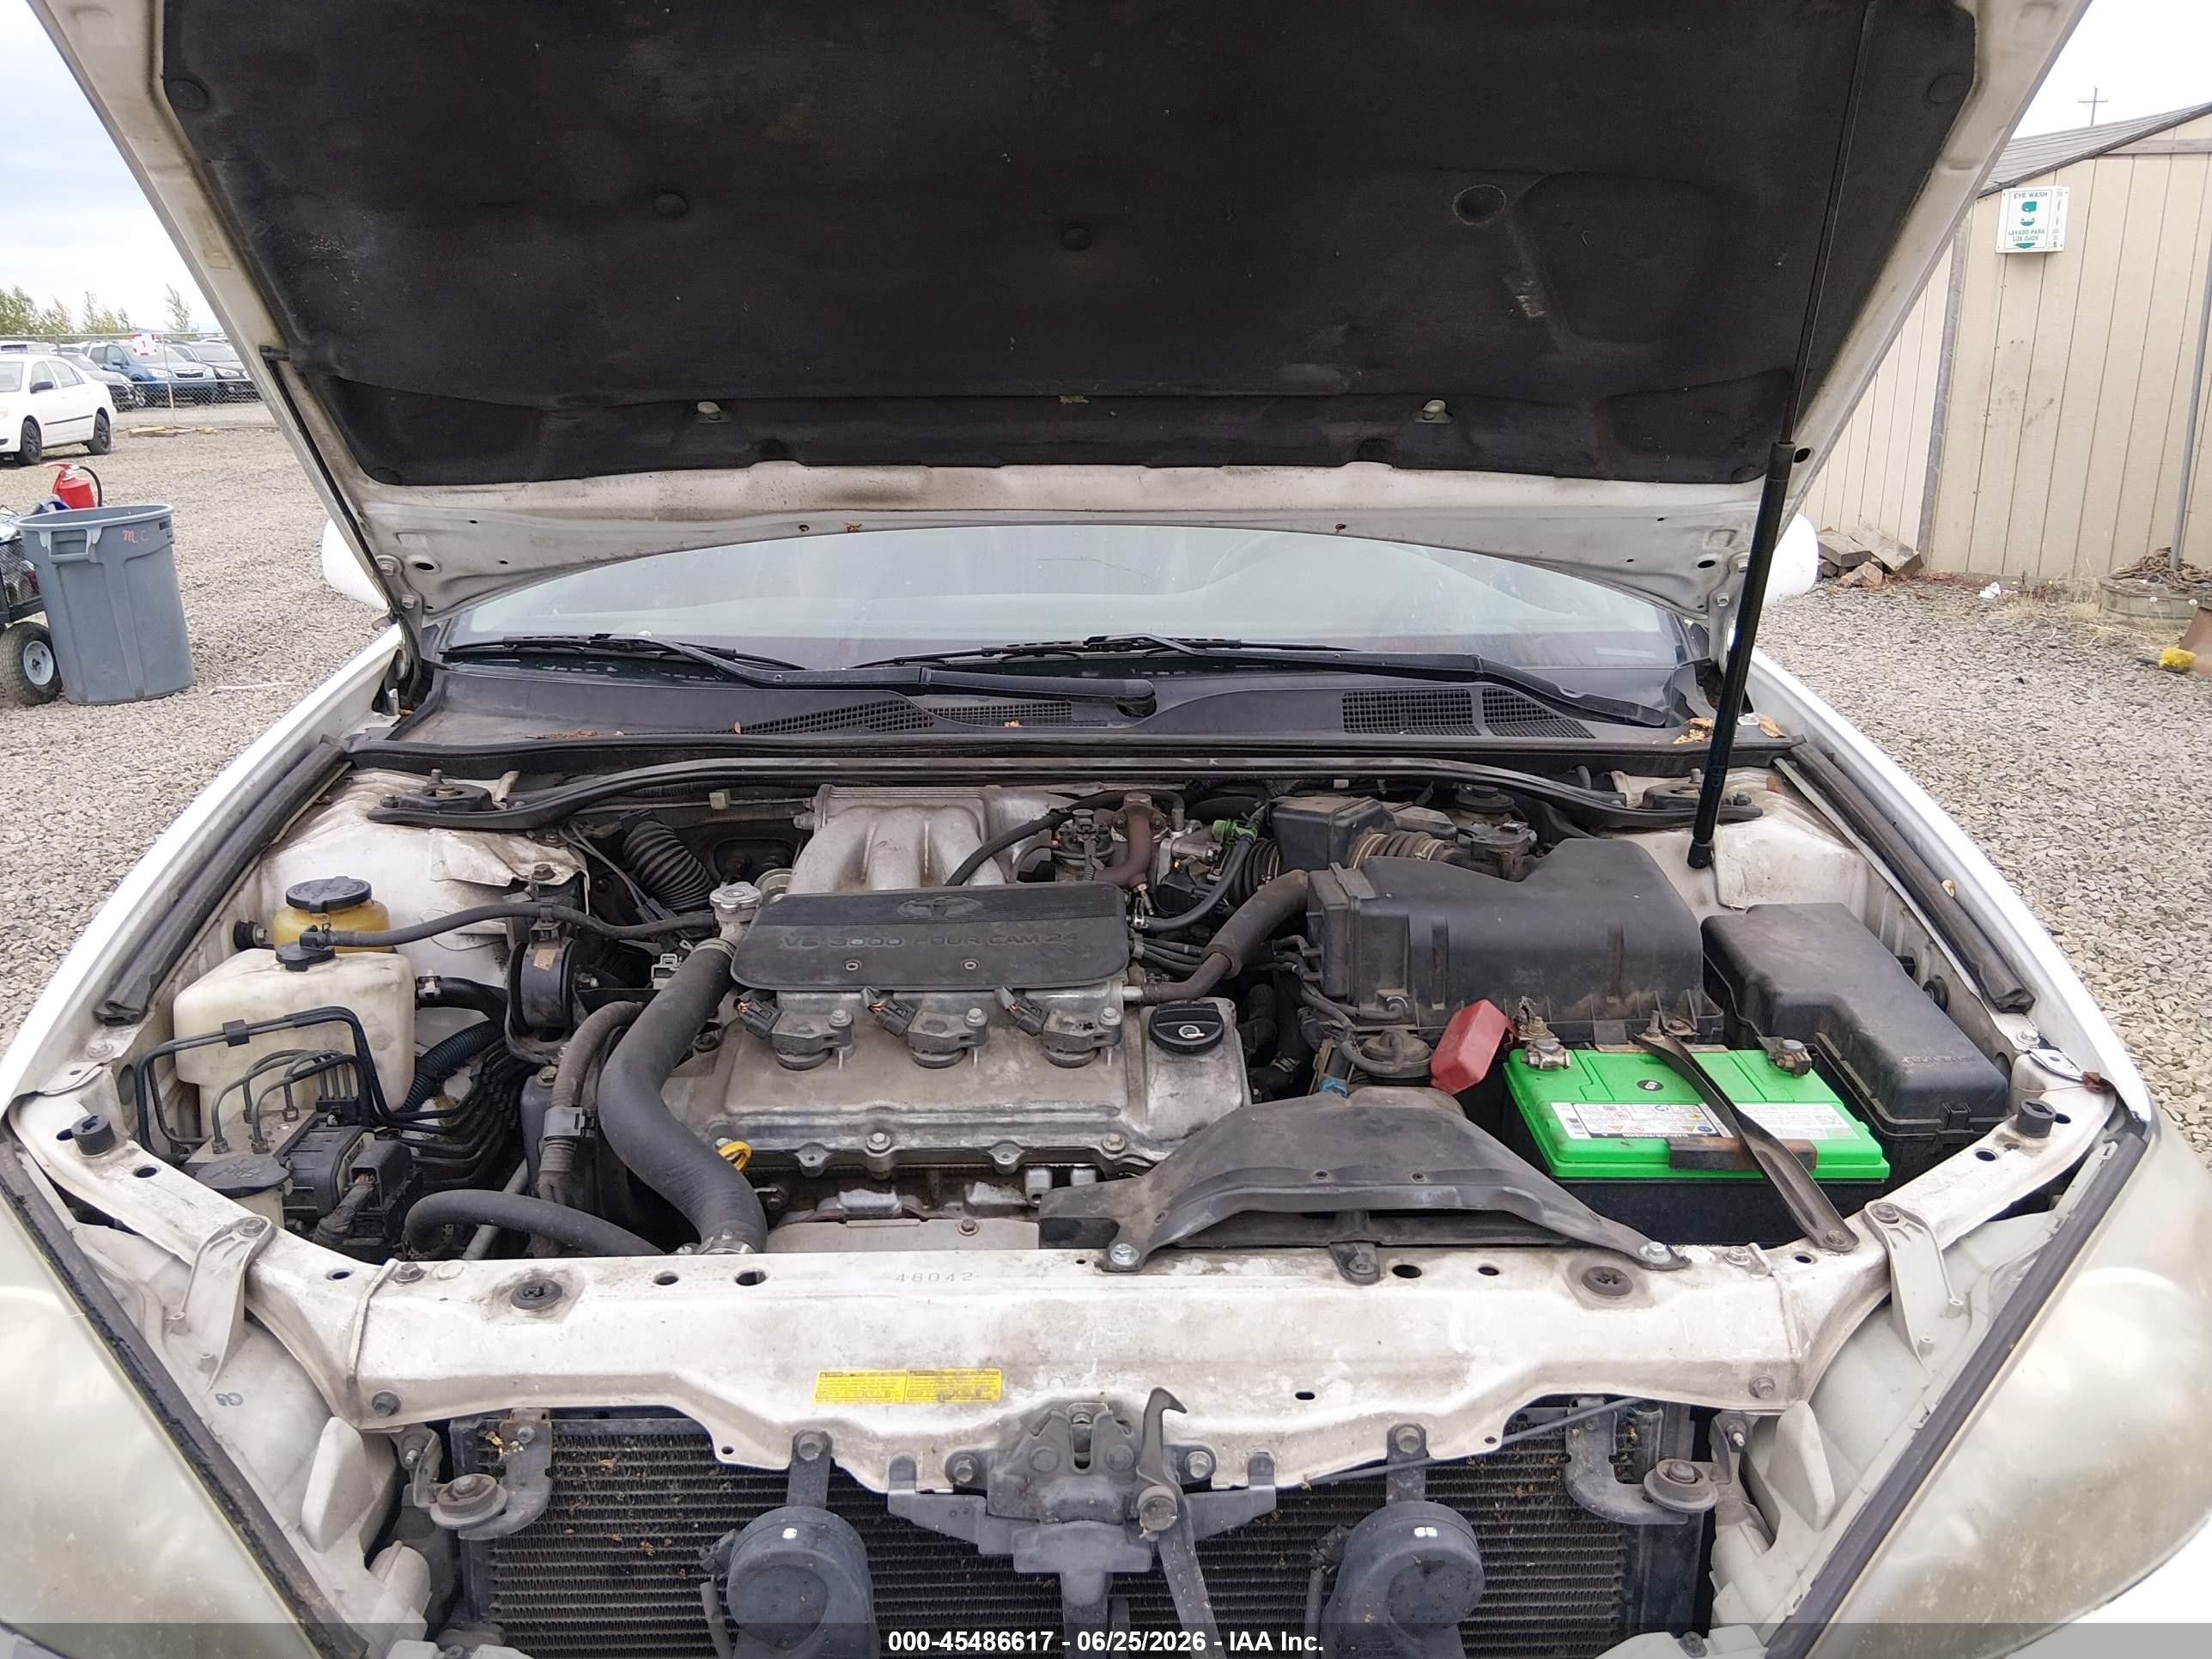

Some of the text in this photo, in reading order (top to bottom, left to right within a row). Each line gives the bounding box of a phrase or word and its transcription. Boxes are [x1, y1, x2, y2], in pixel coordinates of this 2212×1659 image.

[781, 932, 1079, 948] V6 3000 FOUR CAM 24
[895, 1271, 974, 1283] 48042
